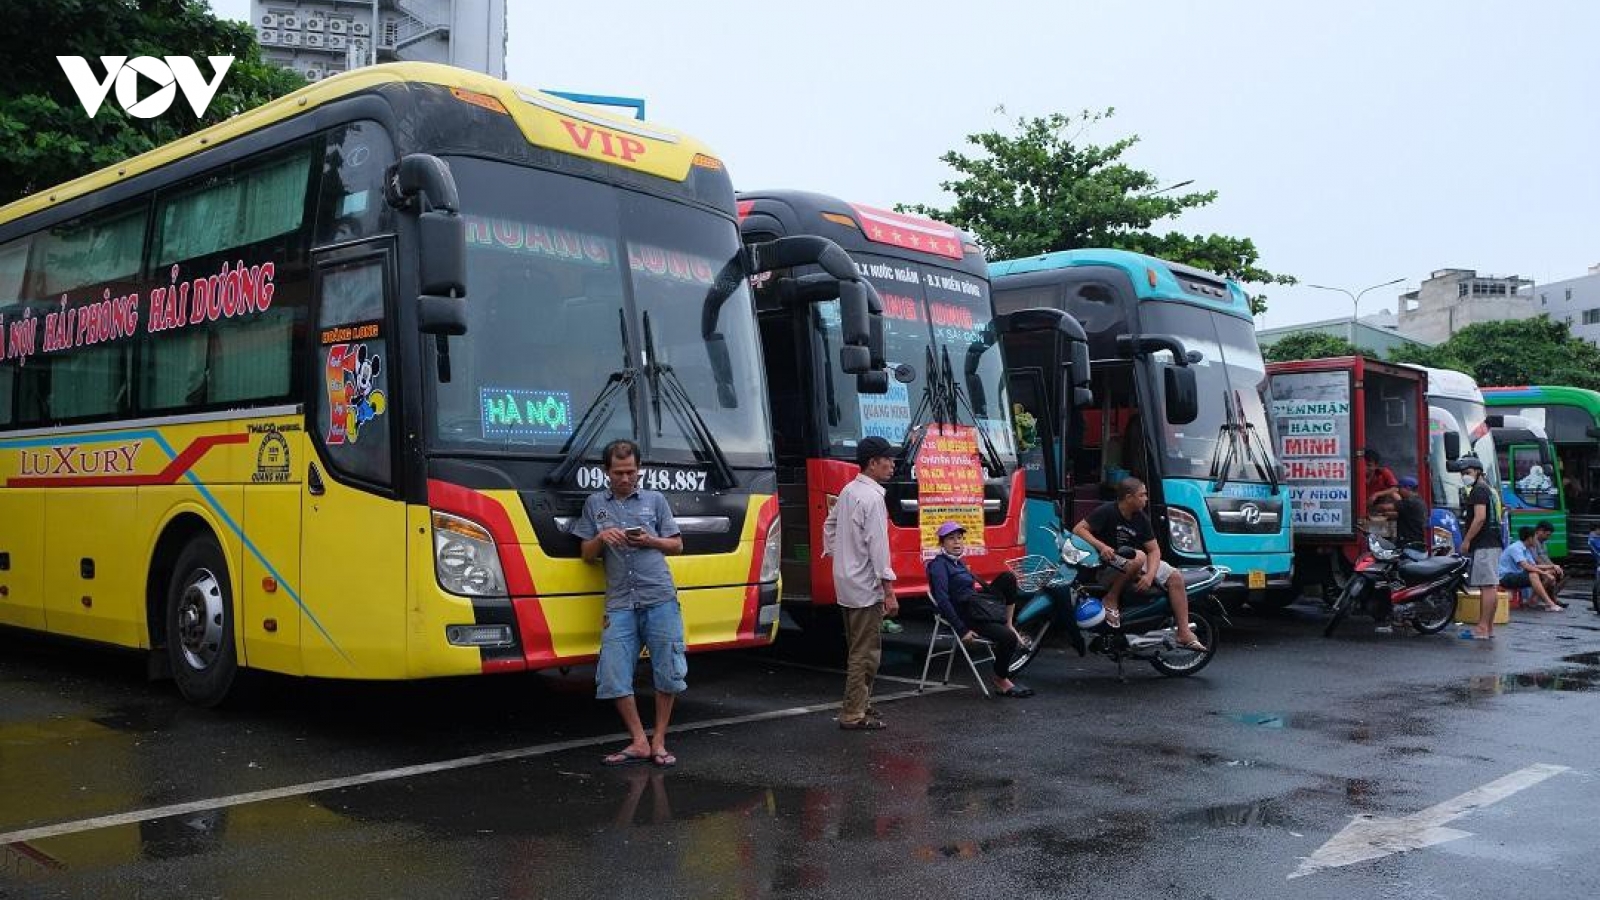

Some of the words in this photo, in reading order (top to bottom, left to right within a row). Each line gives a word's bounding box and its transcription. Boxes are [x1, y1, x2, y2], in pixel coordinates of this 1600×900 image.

[560, 119, 646, 162] VIP
[43, 293, 77, 351] HẢI
[149, 264, 190, 332] HẢI
[190, 260, 275, 324] DƯƠNG
[487, 394, 523, 425] HÀ
[526, 396, 567, 431] NỘI
[20, 441, 142, 475] LUXURY
[1285, 438, 1336, 455] MINH
[1289, 489, 1305, 499] UY
[1293, 509, 1308, 523] ÀI
